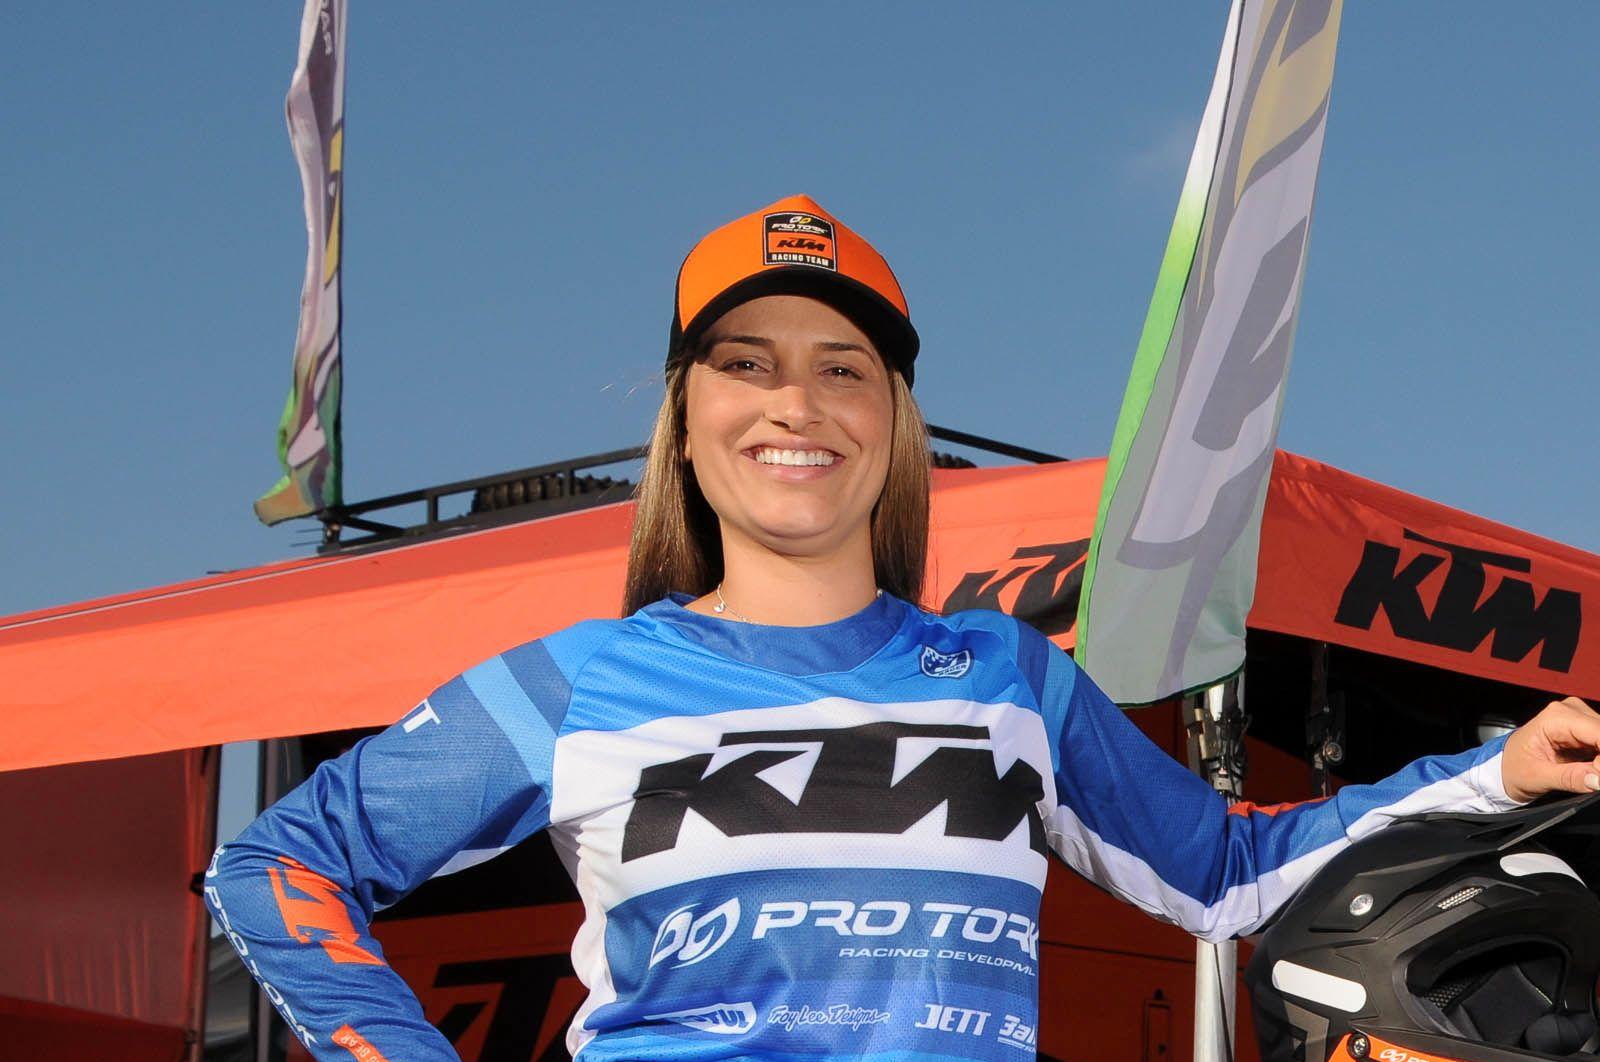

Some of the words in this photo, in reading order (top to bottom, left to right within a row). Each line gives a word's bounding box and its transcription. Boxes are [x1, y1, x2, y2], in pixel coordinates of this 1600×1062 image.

[772, 253, 804, 262] RACING
[805, 256, 829, 266] TEAM
[777, 237, 826, 252] KTM
[1334, 529, 1583, 674] KTM
[621, 722, 1049, 865] KTM
[752, 901, 911, 940] PRO
[921, 902, 1040, 961] TORK
[838, 948, 931, 959] RACING
[914, 1003, 992, 1037] JETT
